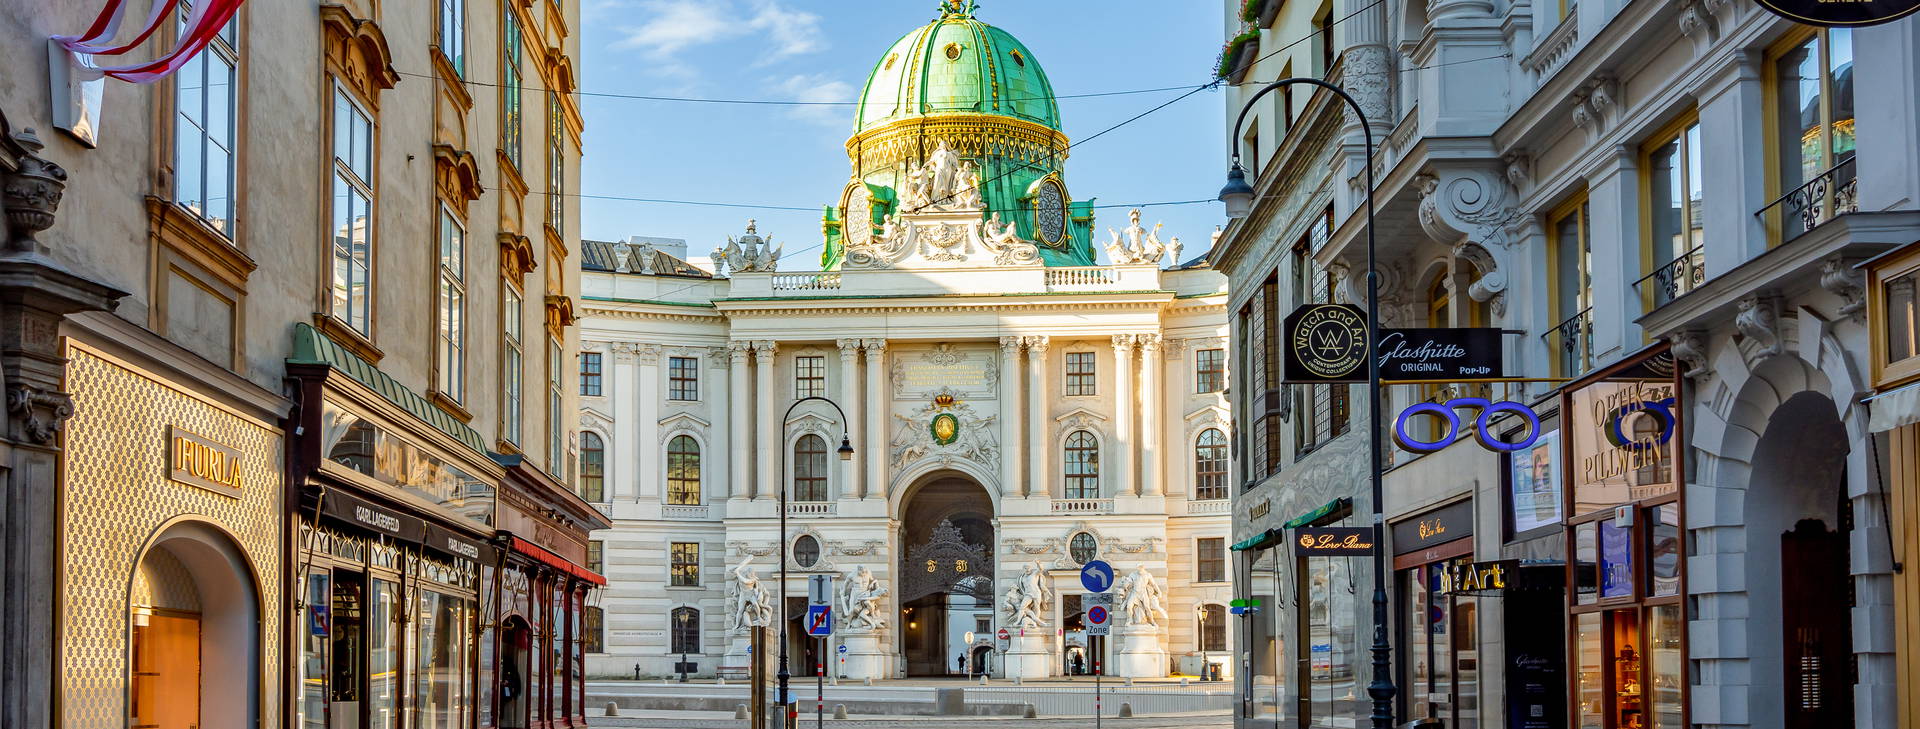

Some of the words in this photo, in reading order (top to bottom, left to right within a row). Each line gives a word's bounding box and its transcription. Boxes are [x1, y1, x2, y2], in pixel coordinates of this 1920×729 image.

[1297, 311, 1325, 349] Watch
[1328, 310, 1357, 326] and
[1351, 328, 1364, 347] Art
[1307, 361, 1326, 373] UNIQUE
[1326, 359, 1358, 374] COLLECTIONS
[1313, 356, 1352, 368] CONTEMPORARY
[1400, 363, 1444, 372] ORIGINAL
[1595, 381, 1646, 428] OPTIK
[175, 437, 242, 488] FURLA
[1584, 432, 1664, 485] PILLWEIN
[356, 505, 372, 524] KARL
[371, 510, 400, 533] LAGERFELD
[1314, 534, 1342, 549] Loro
[1342, 533, 1373, 549] Piana
[1463, 564, 1505, 591] Art
[1089, 626, 1107, 634] Zone
